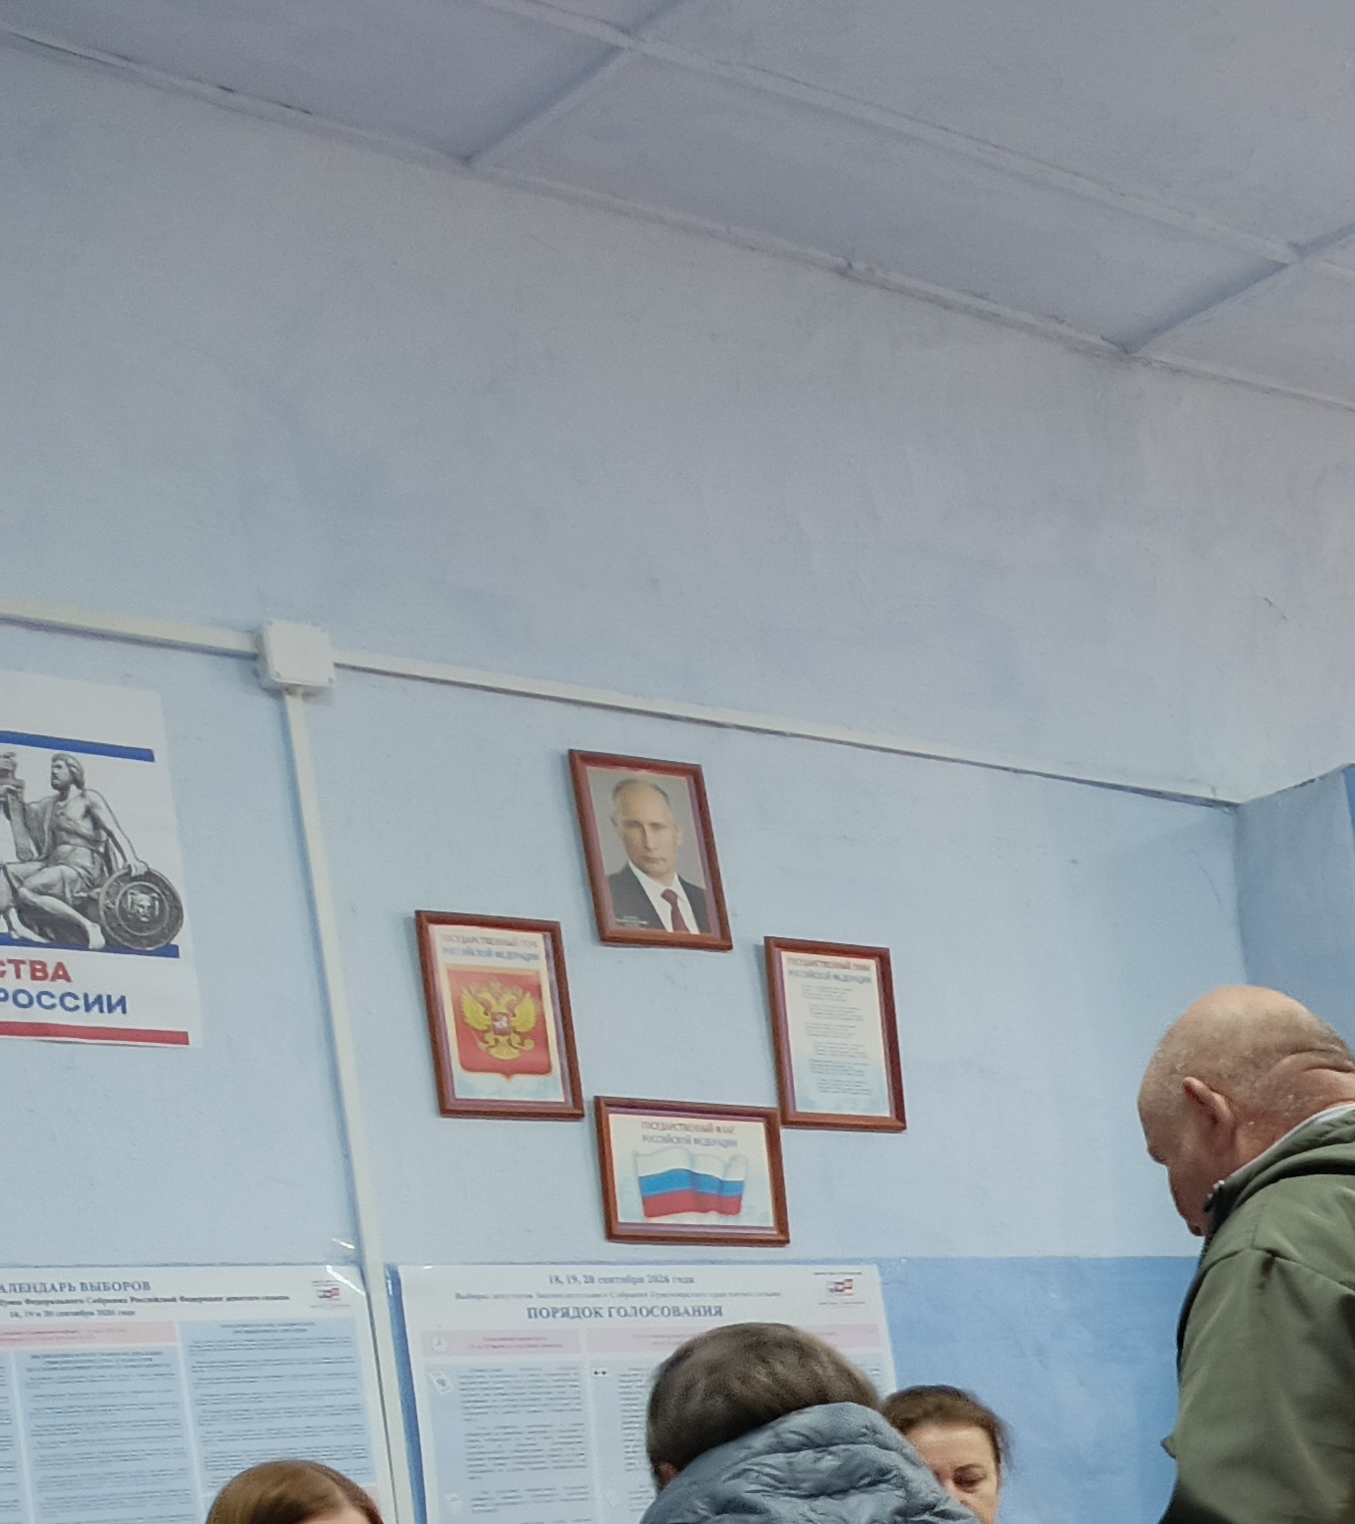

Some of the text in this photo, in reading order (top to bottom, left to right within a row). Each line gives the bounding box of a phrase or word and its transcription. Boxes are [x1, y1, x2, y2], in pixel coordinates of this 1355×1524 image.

[79, 1280, 152, 1293] ВЫБОРОВ
[526, 1305, 724, 1320] ПОРЯДОК ГОЛОСОВАНИЯ
